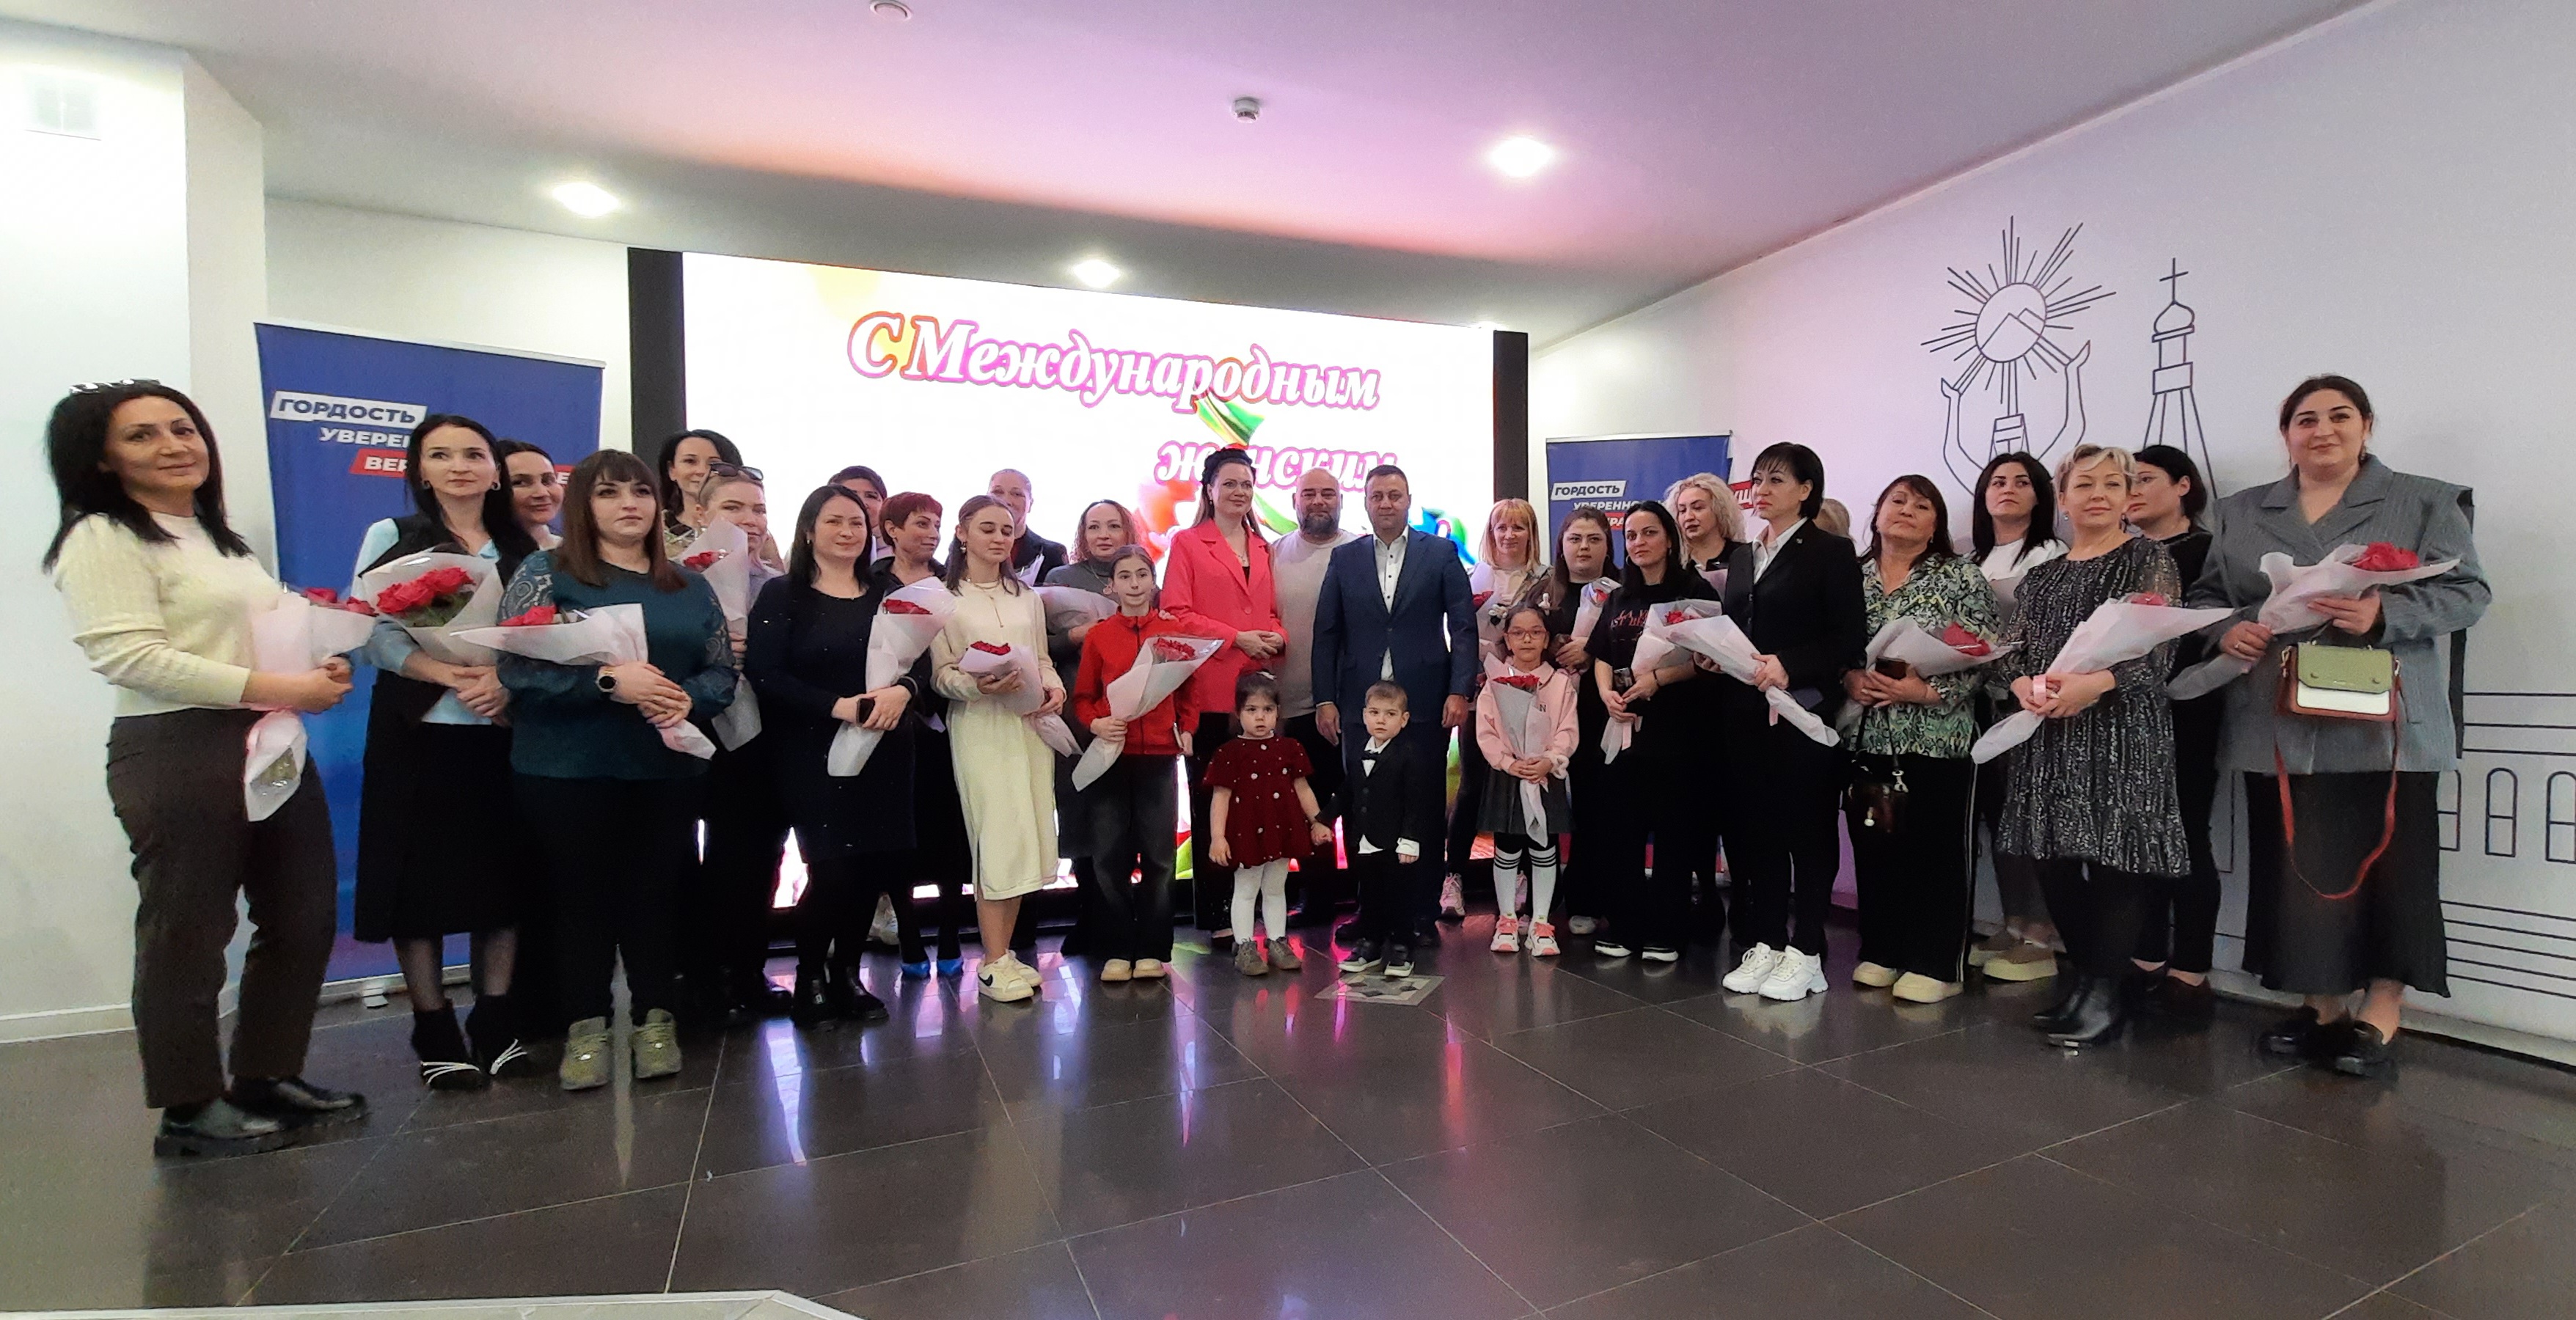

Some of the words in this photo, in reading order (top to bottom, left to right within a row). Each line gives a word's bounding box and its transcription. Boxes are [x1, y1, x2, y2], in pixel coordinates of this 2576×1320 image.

[849, 310, 905, 377] С
[903, 315, 1380, 413] Международным
[278, 398, 416, 423] ГОРДОСТЬ
[1155, 441, 1397, 492] жнски
[1554, 485, 1620, 496] ГОРДОСТЬ
